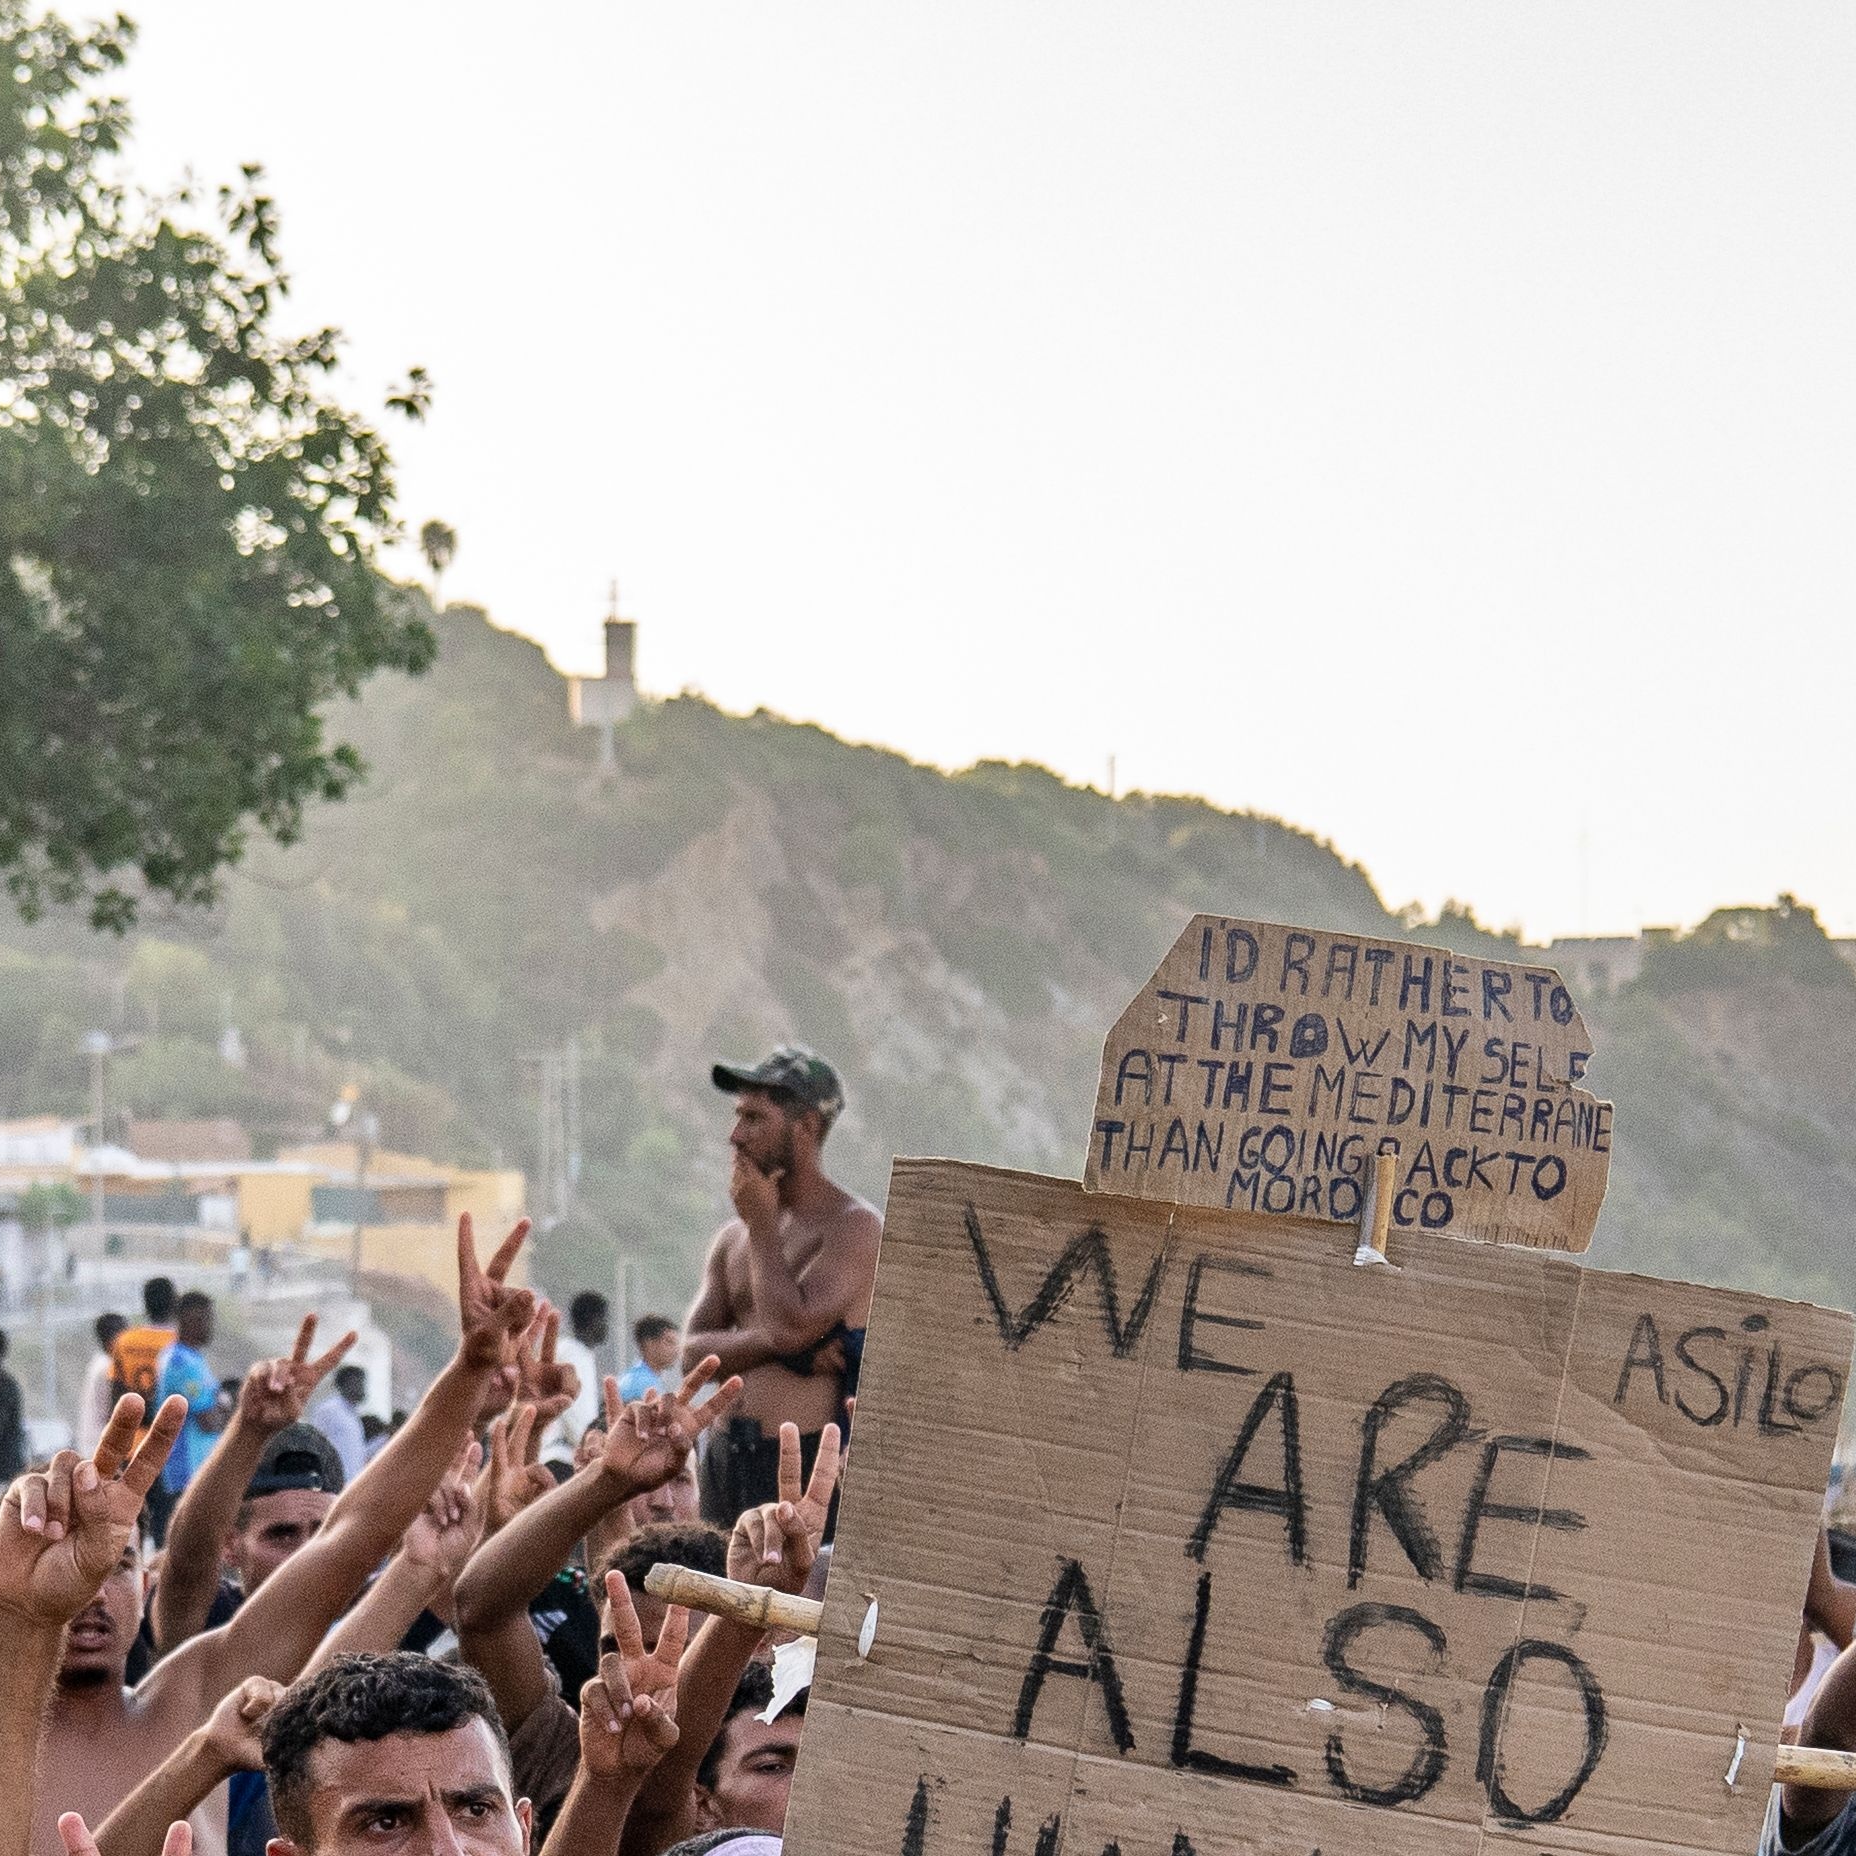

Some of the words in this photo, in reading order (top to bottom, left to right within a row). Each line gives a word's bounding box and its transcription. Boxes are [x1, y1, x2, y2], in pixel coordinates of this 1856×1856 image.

[1199, 918, 1260, 984] I'D
[1280, 933, 1516, 1025] RATHER
[1156, 989, 1391, 1067] THROW
[1095, 1116, 1226, 1174] THAN
[1237, 1124, 1363, 1179] GOING
[1114, 1048, 1189, 1107] AT
[1197, 1057, 1296, 1117] THE
[1310, 1064, 1614, 1155] MEDITERRANE
[963, 1201, 1276, 1378] WE
[1185, 1371, 1596, 1603] ARE
[1012, 1556, 1610, 1830] ALSO
